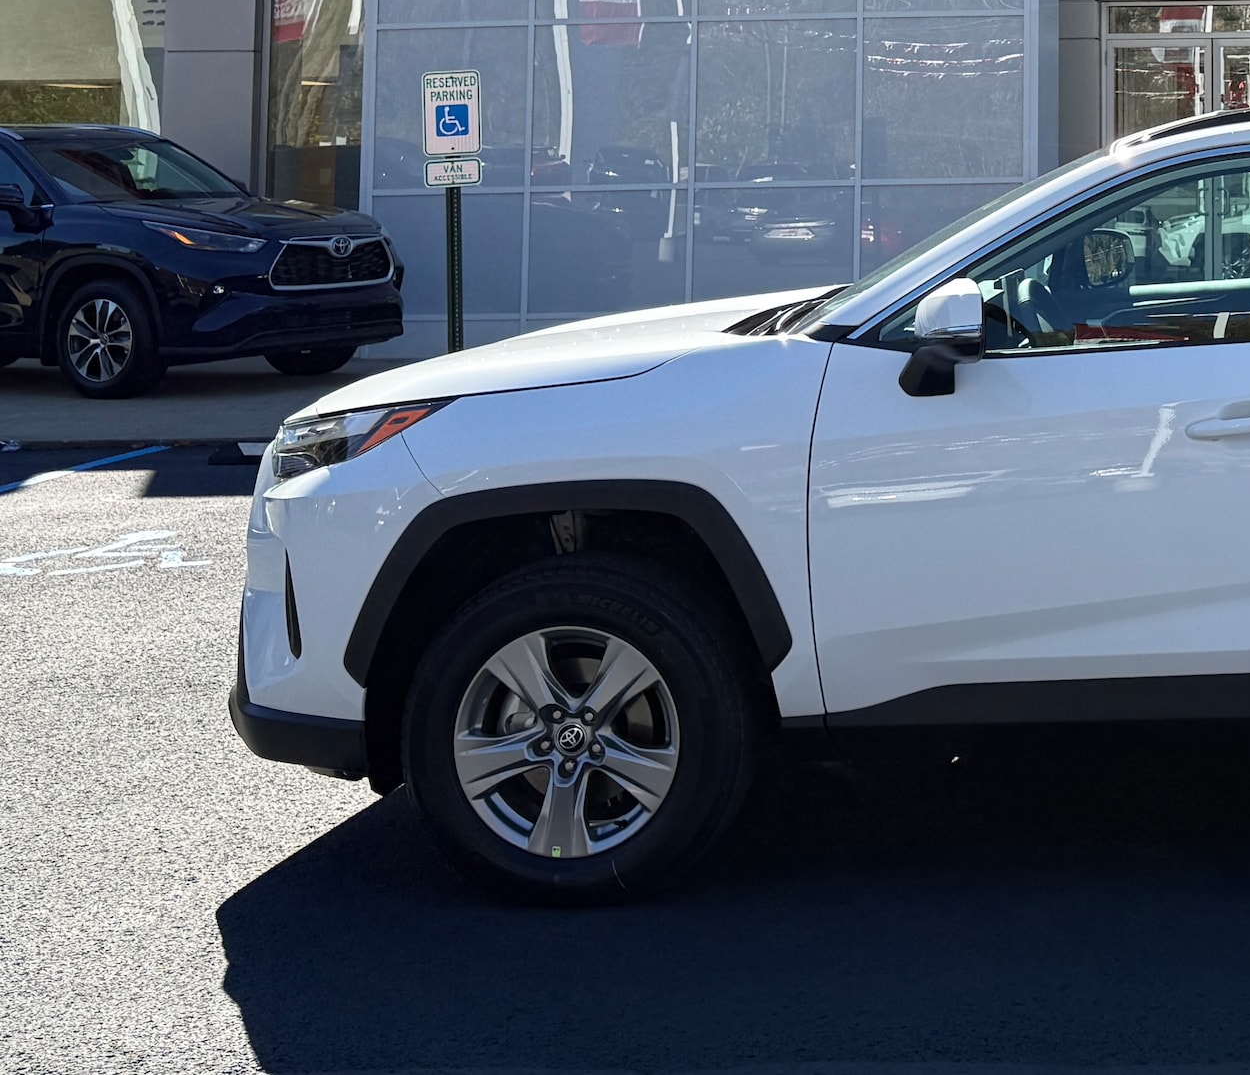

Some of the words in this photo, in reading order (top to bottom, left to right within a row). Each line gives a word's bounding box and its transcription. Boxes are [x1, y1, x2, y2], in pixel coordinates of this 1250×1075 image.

[426, 76, 476, 89] RESERVED
[430, 89, 472, 102] PARKING
[443, 164, 463, 174] VAN
[434, 173, 472, 183] ACCESSIBLE
[577, 593, 659, 635] MICHELIN
